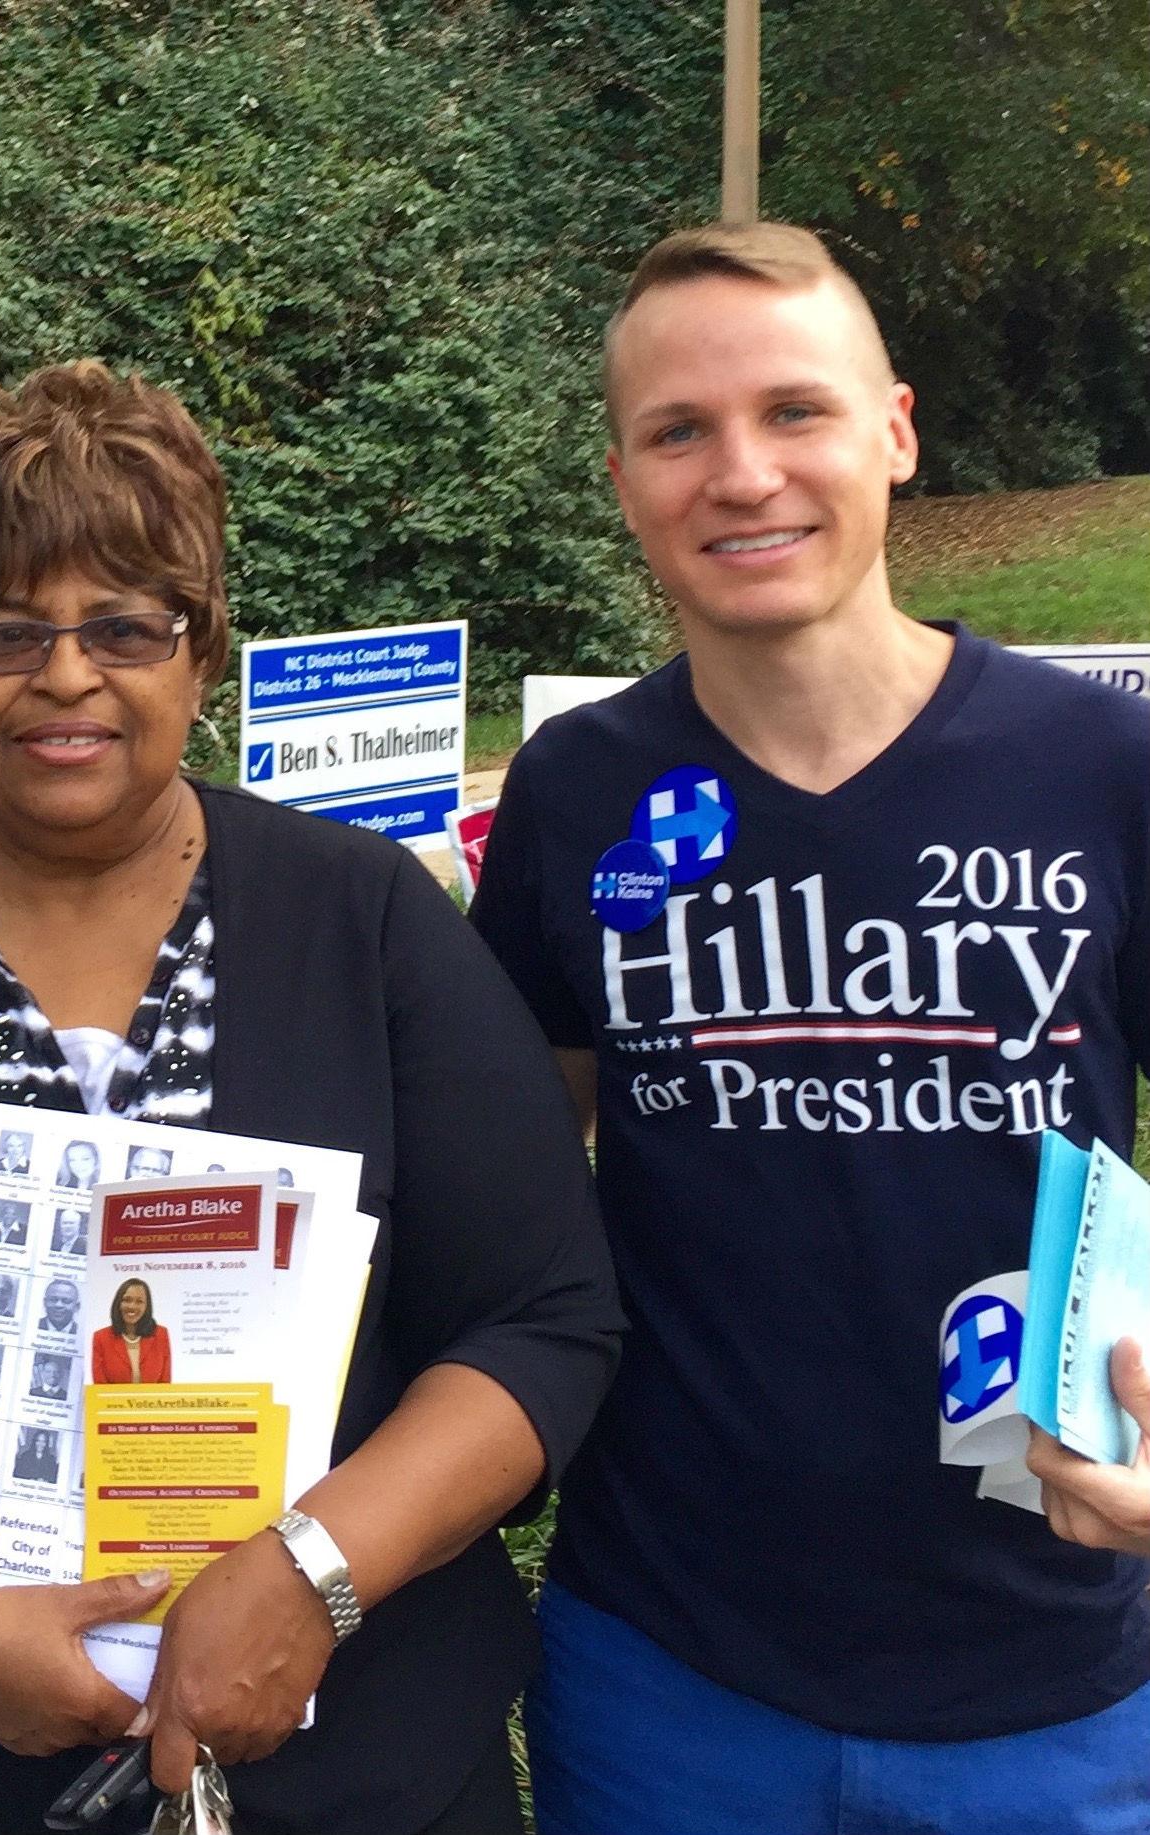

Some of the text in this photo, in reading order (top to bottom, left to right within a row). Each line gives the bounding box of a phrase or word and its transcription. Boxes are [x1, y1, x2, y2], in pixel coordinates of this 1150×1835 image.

[284, 642, 430, 672] NC District Court Judge
[253, 677, 303, 698] District
[304, 675, 323, 691] 26
[332, 665, 412, 689] Mecklenburg
[413, 660, 458, 678] County
[278, 724, 459, 775] Ben S. Thalheimer
[617, 871, 665, 887] Clinton
[617, 885, 655, 900] Kaine
[915, 844, 1087, 915] 2016
[602, 873, 1092, 1062] Hillary
[630, 1052, 1075, 1136] for President
[121, 1199, 243, 1220] Aretha Blake
[113, 1231, 250, 1245] FOR DISTRICT COURT JUDGE
[12, 1540, 51, 1556] City of
